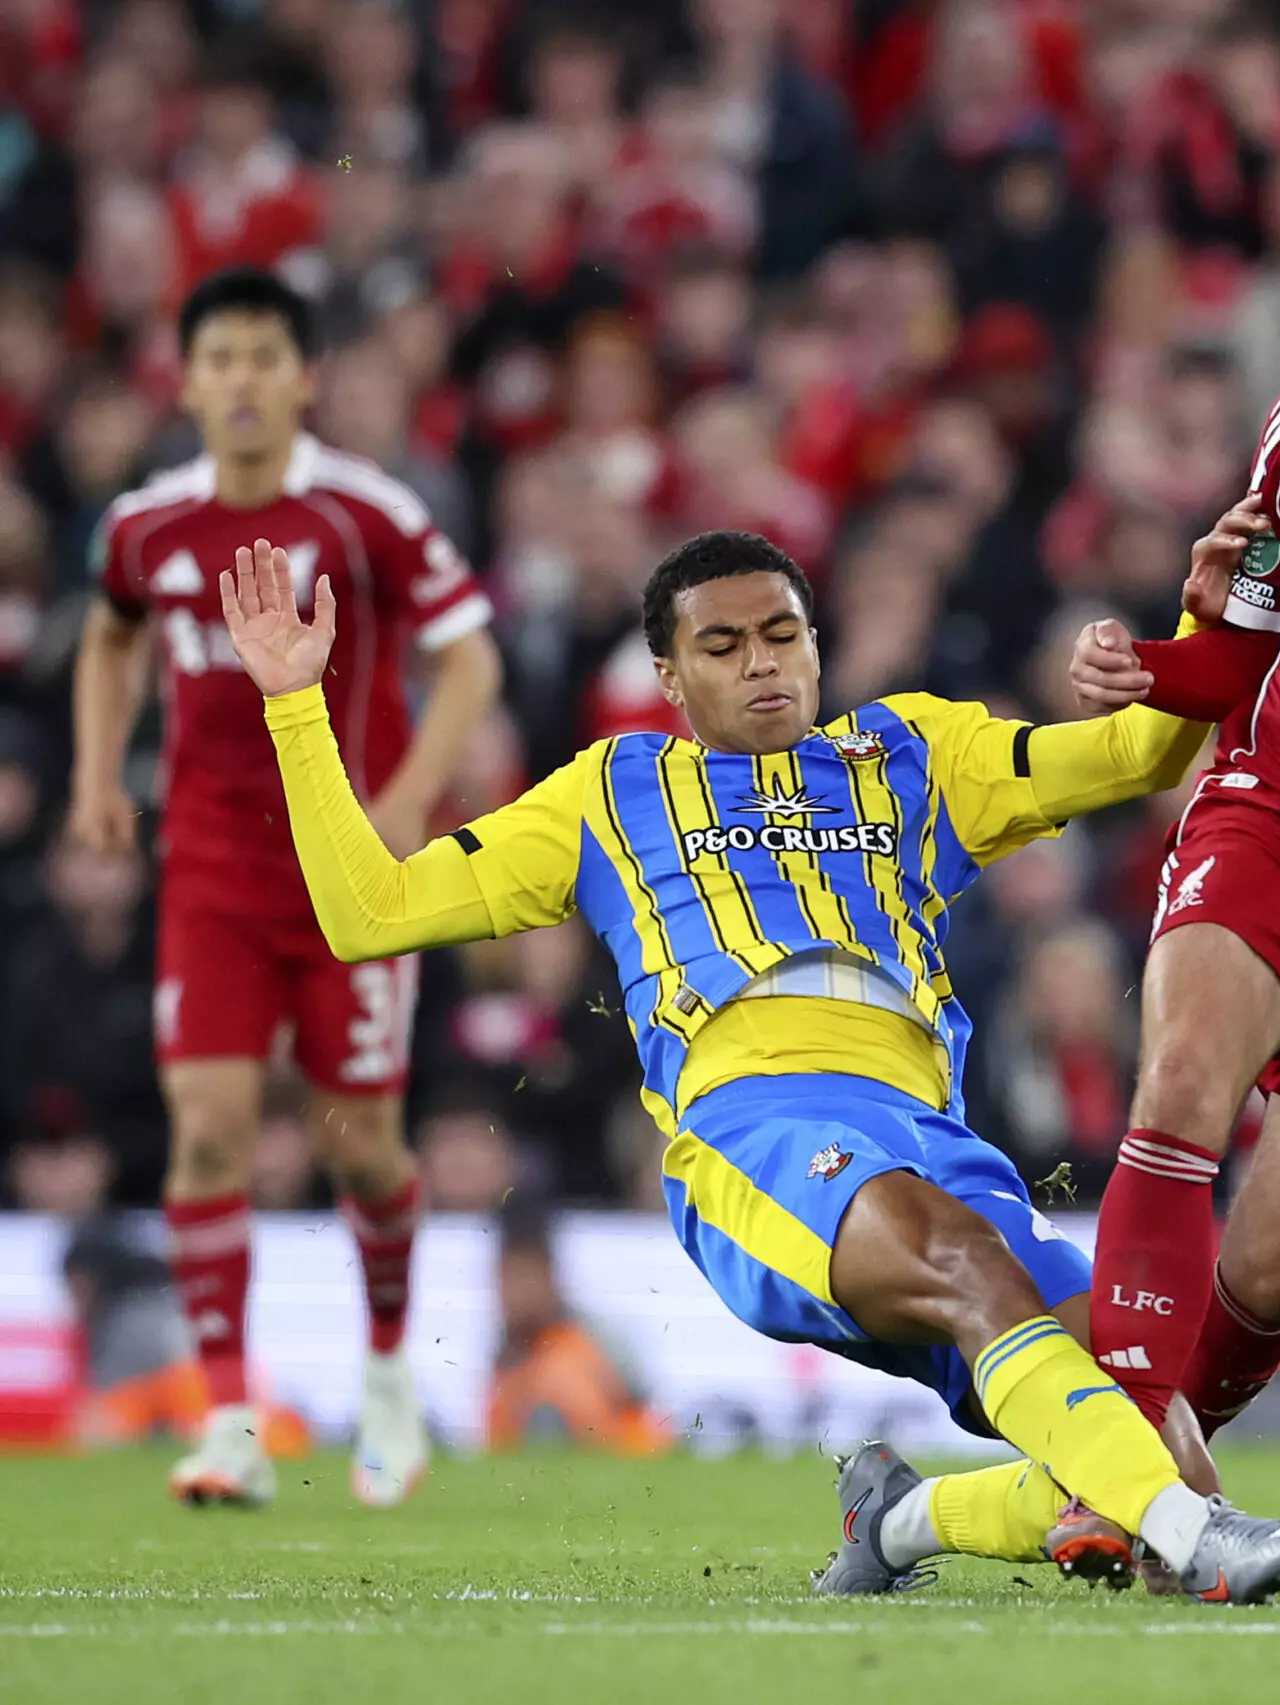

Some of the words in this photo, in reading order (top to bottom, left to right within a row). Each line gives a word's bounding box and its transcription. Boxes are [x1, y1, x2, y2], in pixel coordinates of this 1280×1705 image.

[1239, 575, 1274, 598] room
[683, 826, 755, 861] P&O
[759, 824, 894, 855] CRUISES
[1111, 1284, 1175, 1315] LFC
